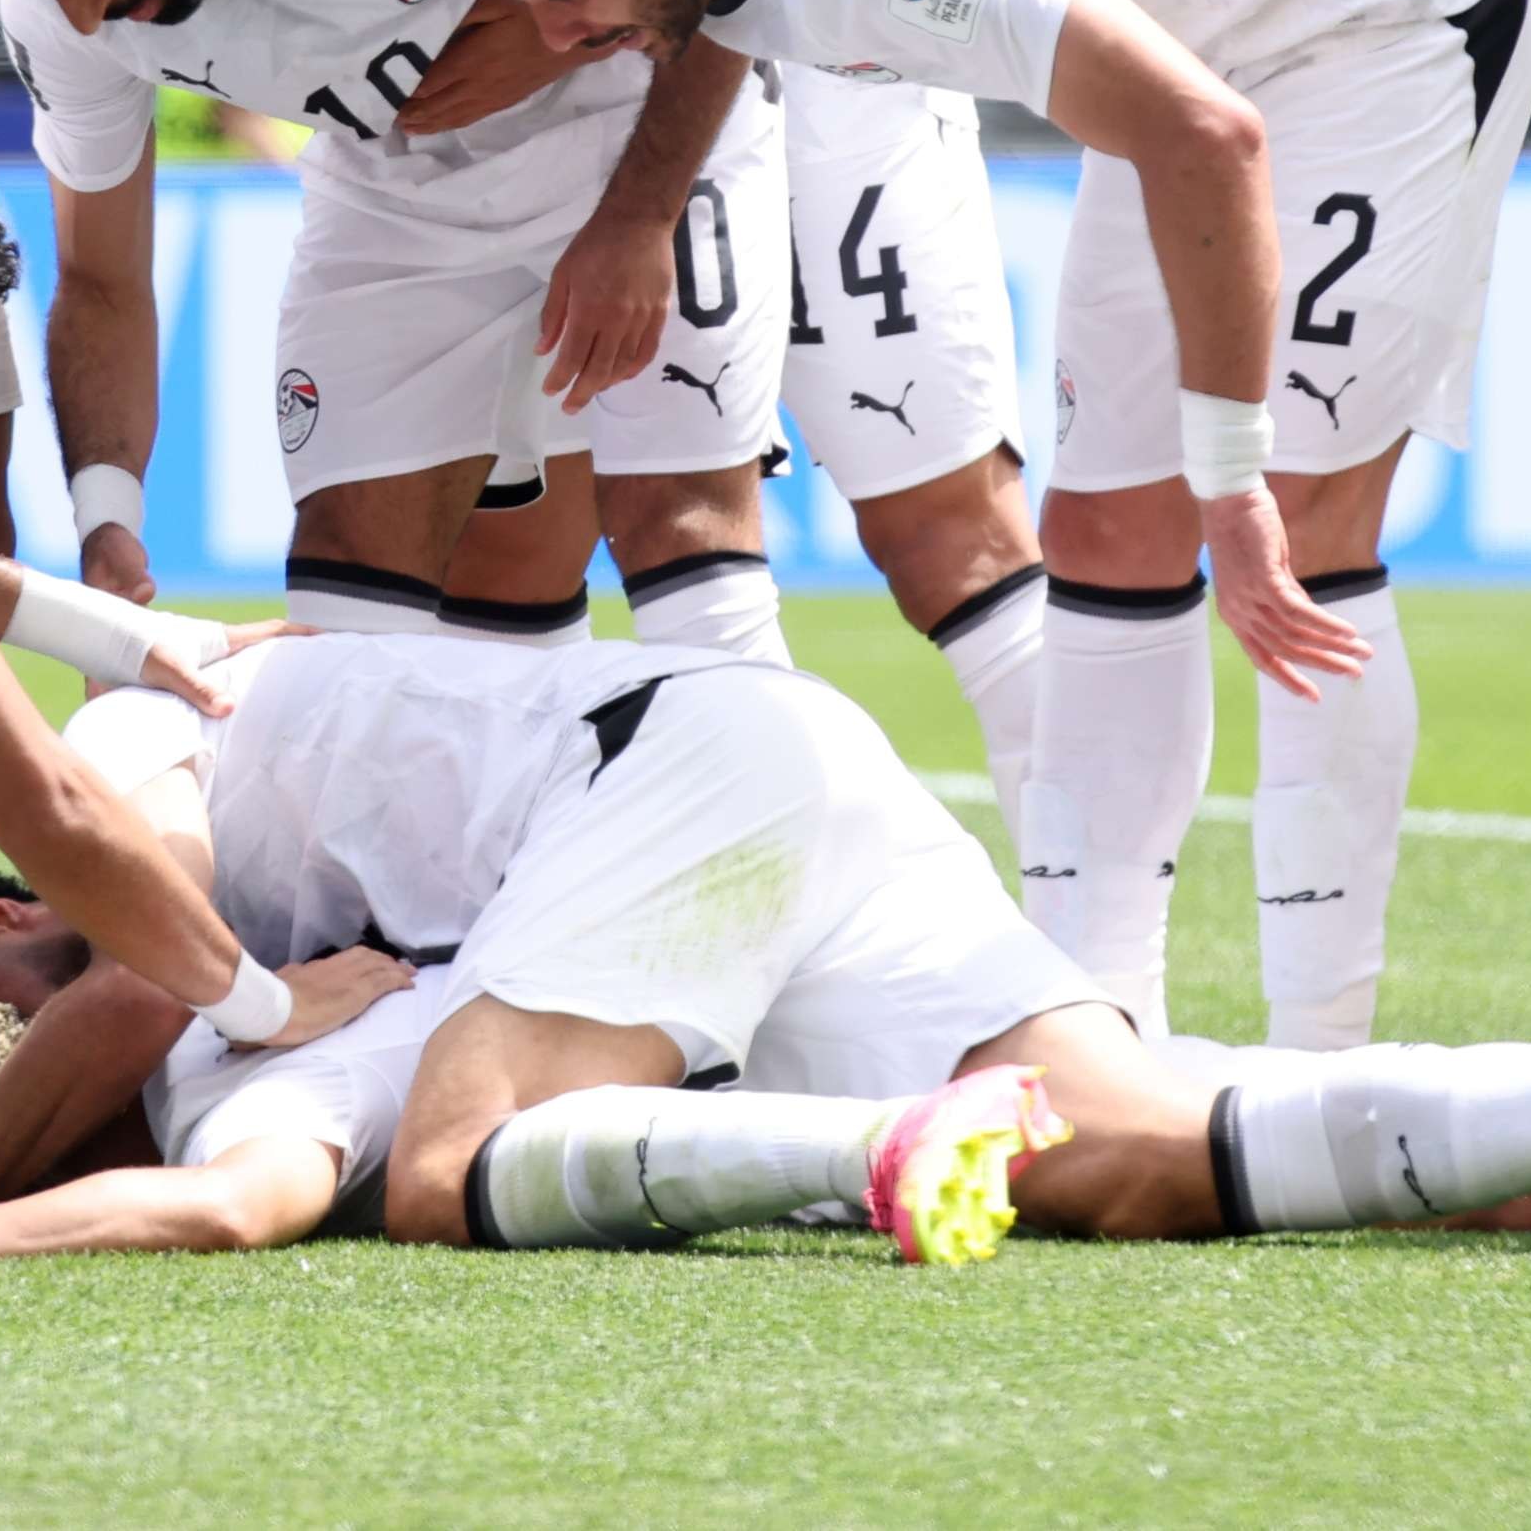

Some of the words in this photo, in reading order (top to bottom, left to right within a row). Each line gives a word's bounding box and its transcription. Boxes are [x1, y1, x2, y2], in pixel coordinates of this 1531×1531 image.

[303, 38, 434, 141] 10
[789, 183, 918, 345] 14
[1291, 192, 1378, 347] 2
